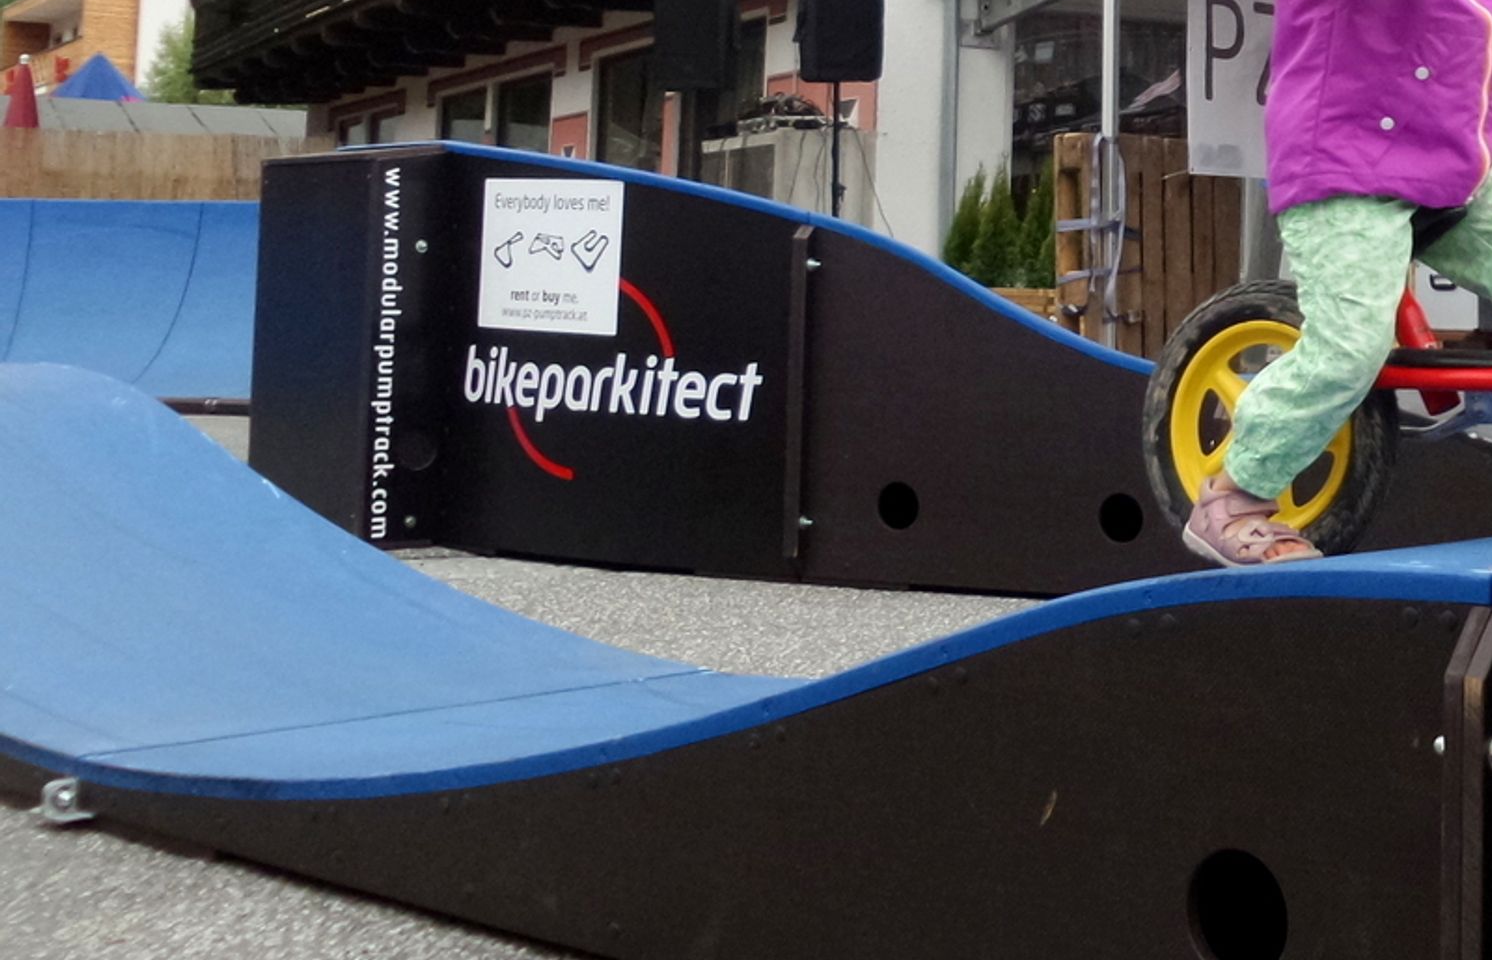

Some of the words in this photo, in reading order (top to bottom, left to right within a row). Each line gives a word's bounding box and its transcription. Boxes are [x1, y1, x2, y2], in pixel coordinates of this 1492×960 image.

[494, 192, 550, 214] Everybody
[553, 194, 585, 211] loves
[587, 196, 611, 212] me!
[510, 290, 530, 301] rent
[542, 290, 561, 305] buy
[371, 167, 402, 539] www.modularpumptrack.com
[464, 344, 763, 422] bikeparkitect
